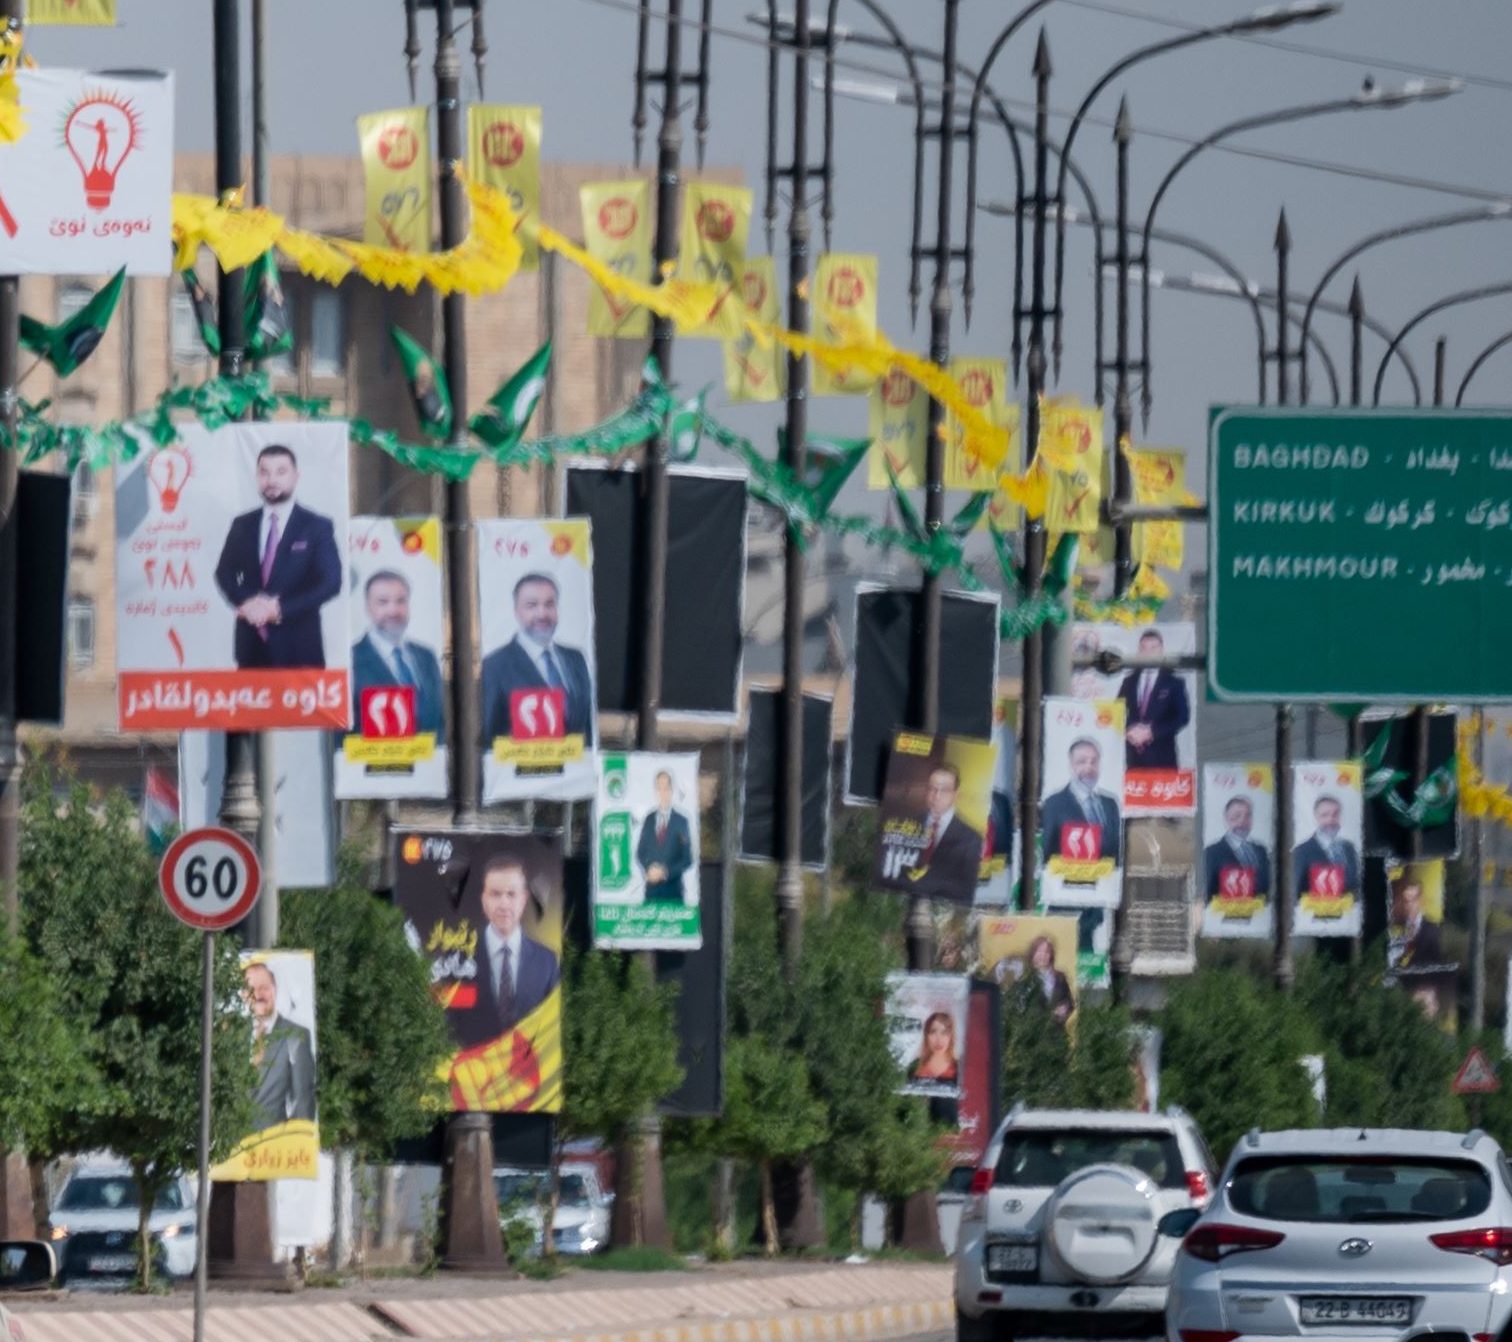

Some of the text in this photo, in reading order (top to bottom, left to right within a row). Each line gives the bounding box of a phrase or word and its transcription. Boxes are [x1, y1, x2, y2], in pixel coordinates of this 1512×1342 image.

[1233, 444, 1370, 470] BAGHDAD
[1233, 500, 1337, 525] KIRKUK
[144, 558, 197, 590] ٢٨٨
[1233, 556, 1399, 581] MAKHMOUR
[282, 678, 344, 713] کاوە
[368, 692, 409, 736] ٢١
[518, 693, 557, 737] ٢١
[185, 856, 238, 899] 60
